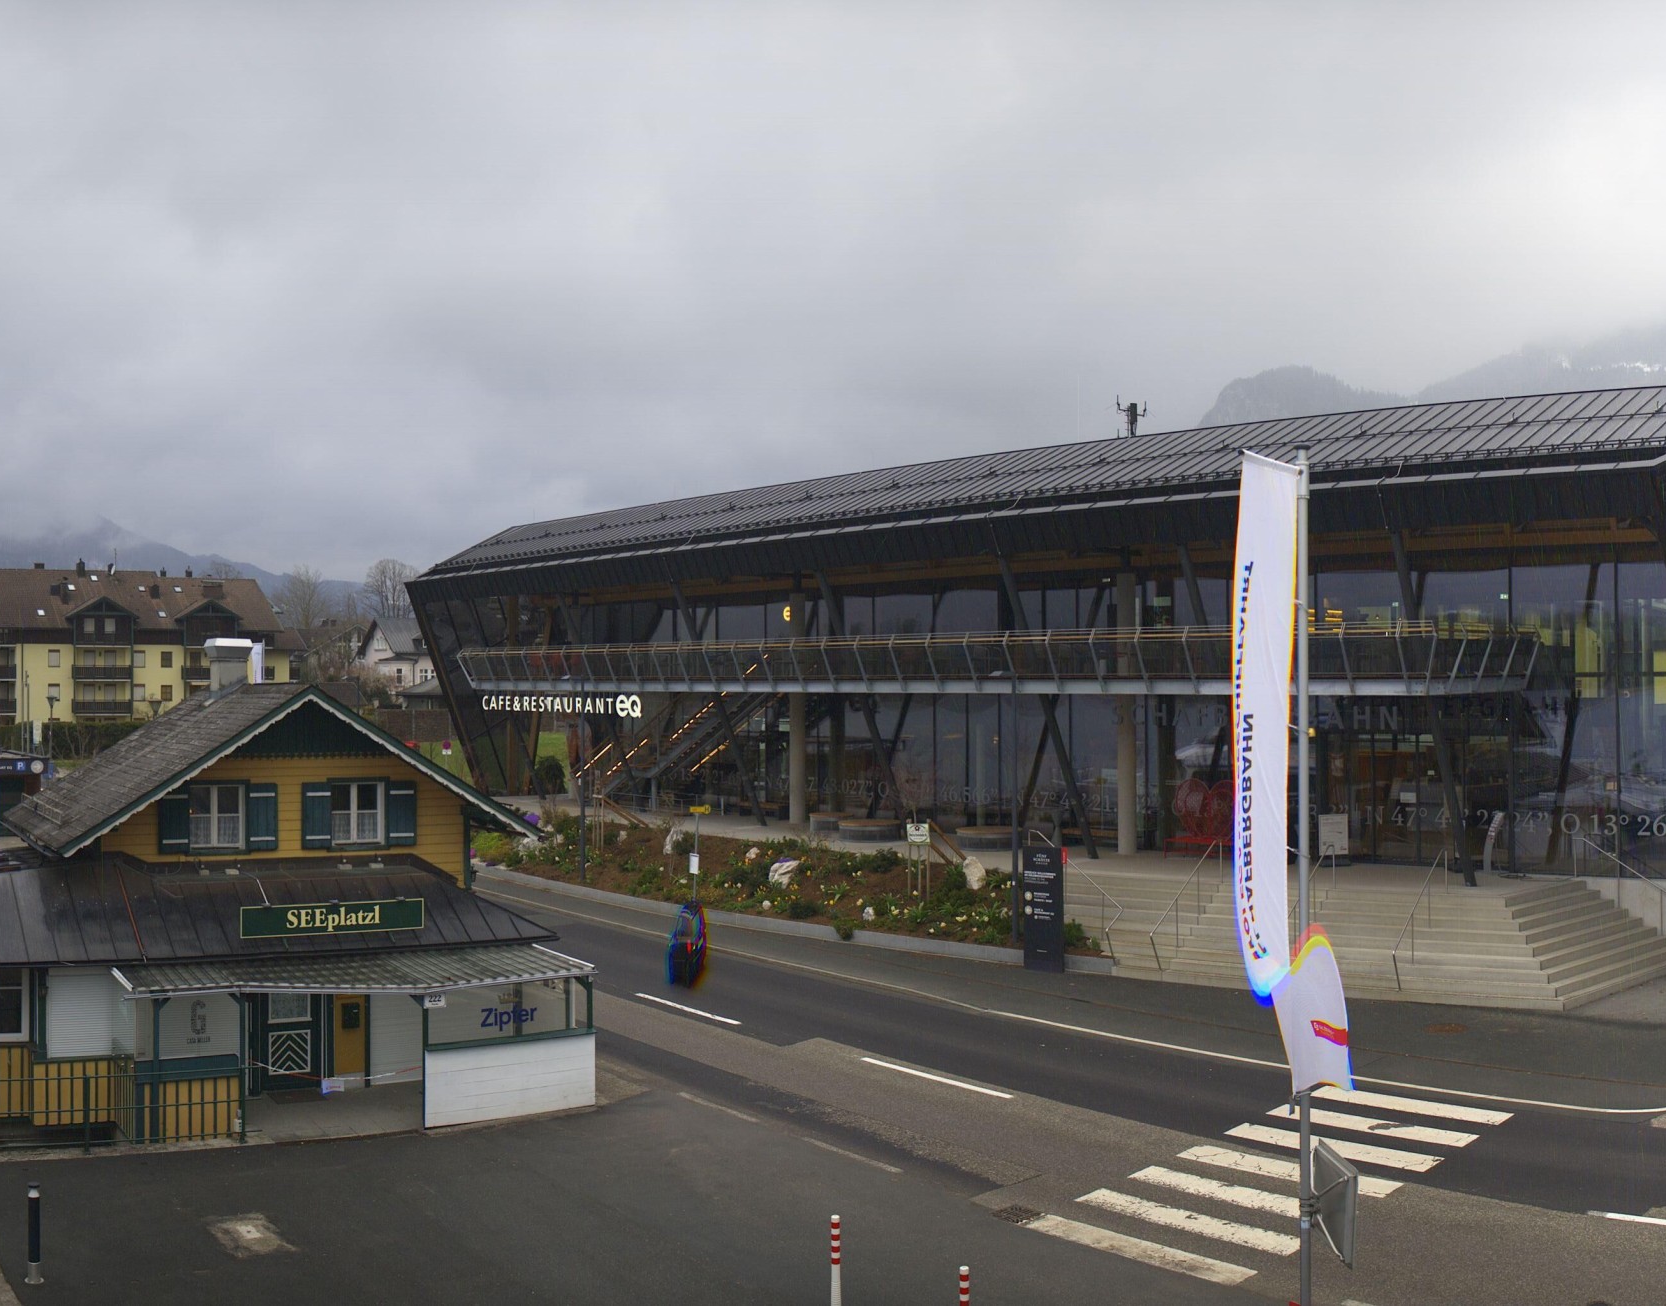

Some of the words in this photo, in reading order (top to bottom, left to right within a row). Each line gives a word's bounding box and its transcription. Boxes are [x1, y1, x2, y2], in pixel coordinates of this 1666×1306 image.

[286, 905, 380, 931] SEEplatzl
[428, 994, 442, 1003] 222
[480, 1004, 538, 1032] Zipfer
